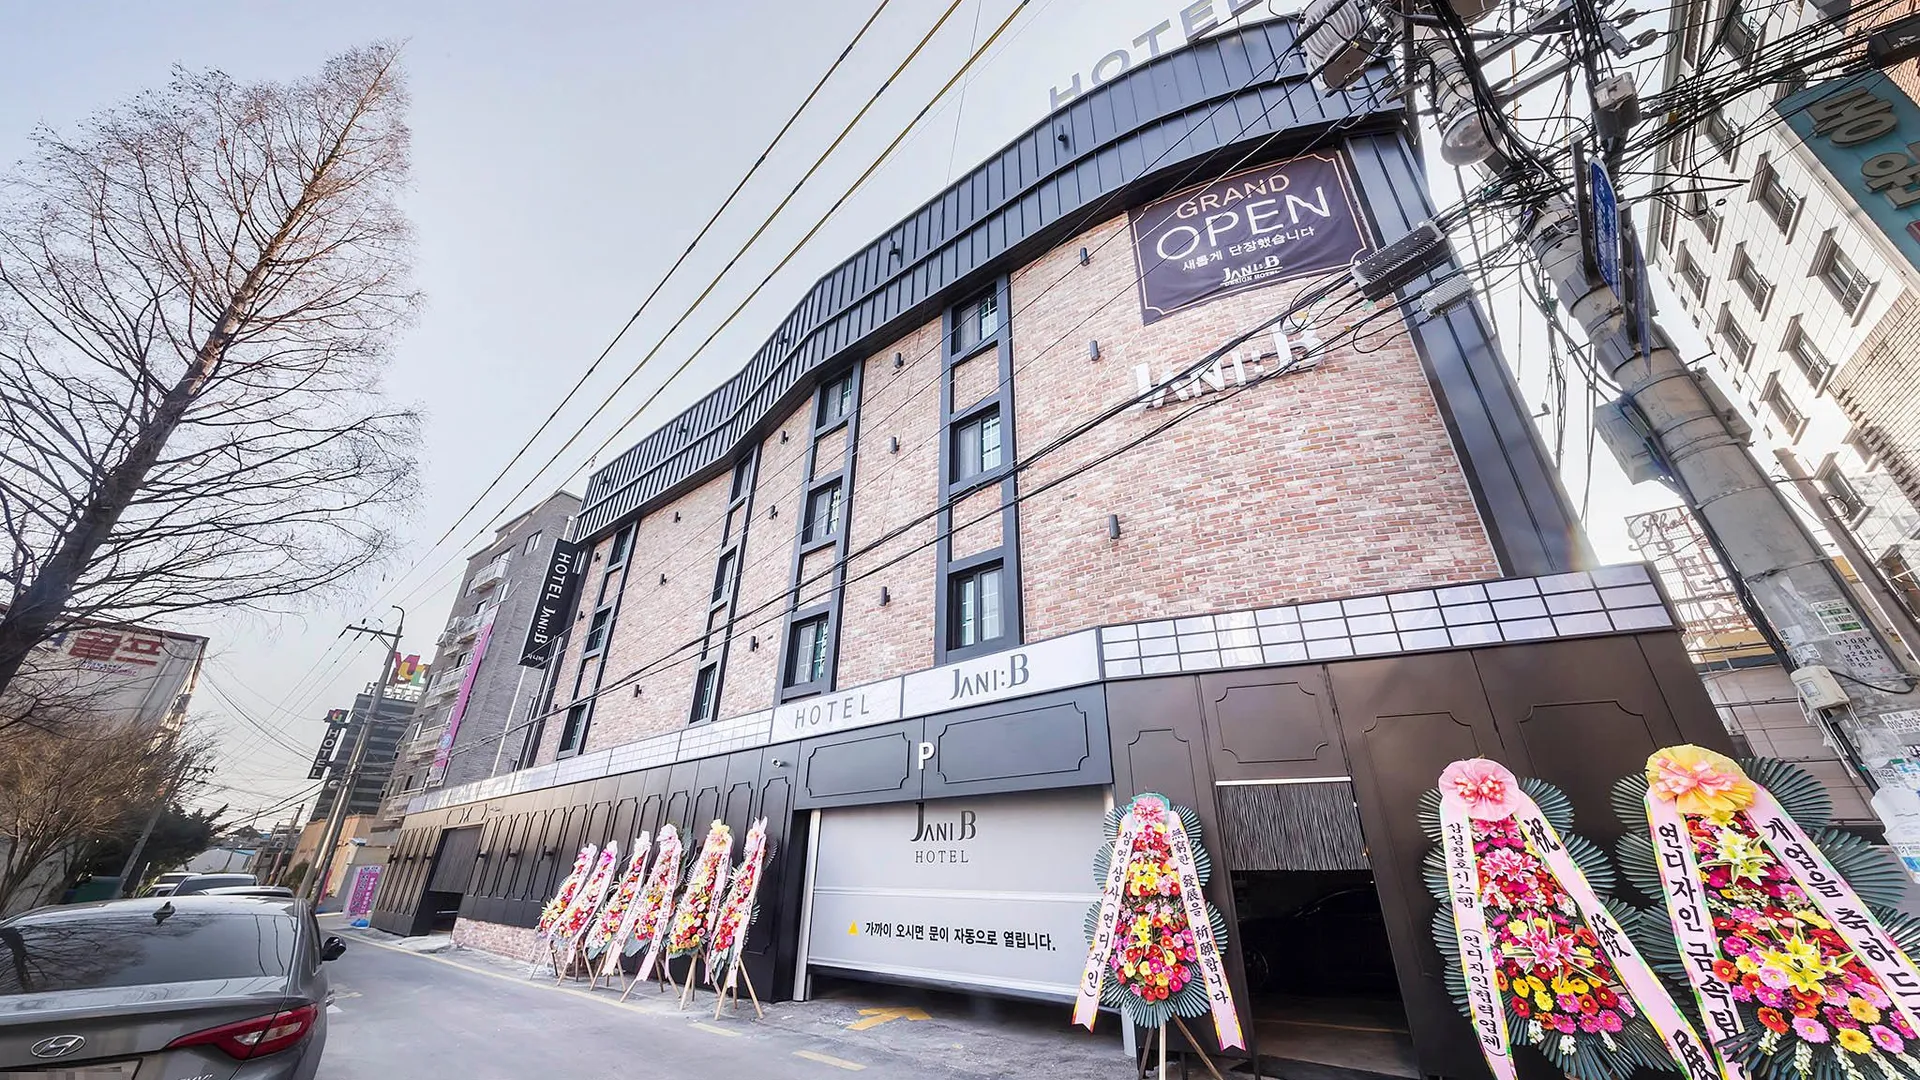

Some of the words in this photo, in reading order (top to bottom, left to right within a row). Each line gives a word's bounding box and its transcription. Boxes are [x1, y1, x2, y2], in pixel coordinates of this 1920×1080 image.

[1176, 174, 1290, 220] GRAND
[1156, 186, 1331, 260] OPEN
[1183, 249, 1223, 271] 새롭게
[1228, 226, 1316, 257] 단장했습니다
[547, 551, 573, 600] HOTEL
[794, 694, 870, 729] HOTEL
[311, 729, 339, 779] HOTEL
[917, 742, 935, 770] P
[915, 850, 969, 863] HOTEL
[1657, 822, 1704, 932] 연디자인
[1762, 817, 1843, 898] 개업을
[864, 921, 892, 938] 가까이
[896, 923, 925, 940] 오시면
[928, 925, 949, 943] 문이
[954, 927, 998, 946] 자동으로
[1003, 930, 1057, 951] 열립니다.
[1183, 874, 1203, 917] 發展을
[1195, 926, 1229, 1005] 祈願합니다
